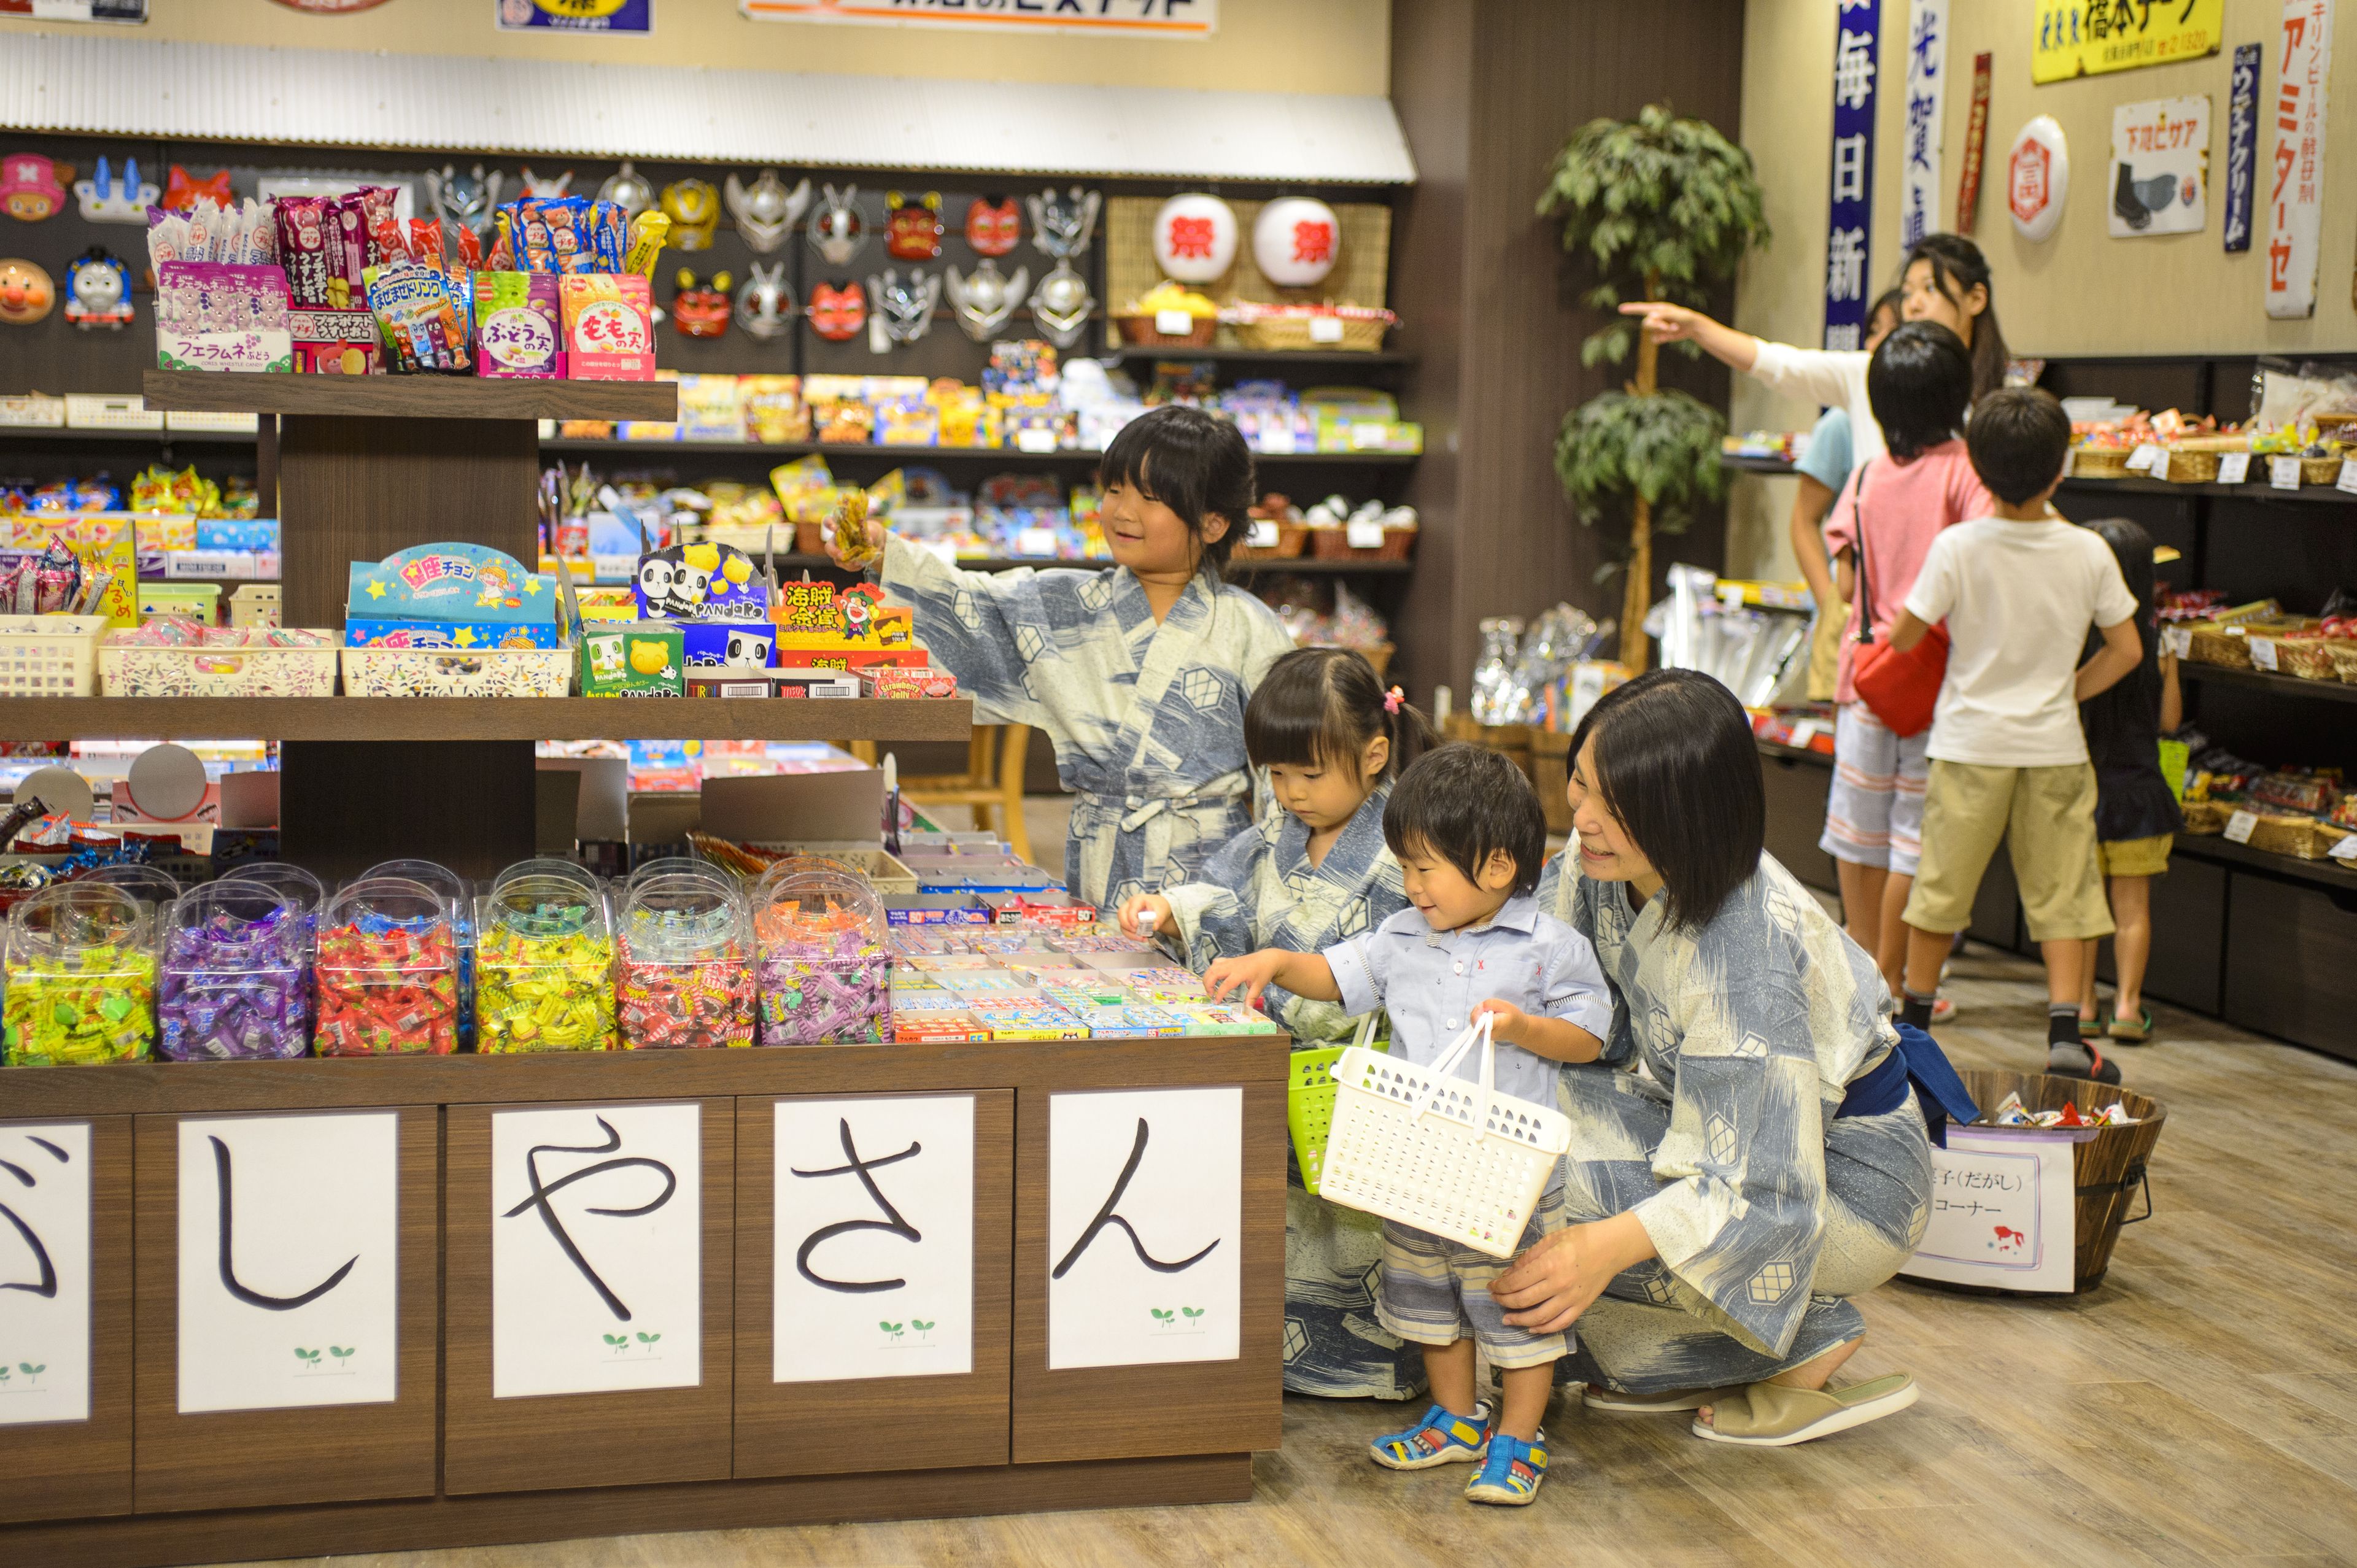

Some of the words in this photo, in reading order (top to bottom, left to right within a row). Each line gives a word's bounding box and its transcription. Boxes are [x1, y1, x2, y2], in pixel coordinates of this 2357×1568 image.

[374, 281, 440, 311] まぜまぜドリンク
[314, 315, 373, 328] プチポテト
[486, 323, 551, 352] ぶどうの実
[582, 315, 642, 349] ももの実
[177, 342, 246, 360] フェラムネ
[247, 350, 270, 361] ぶどう
[786, 585, 833, 607] 海賊
[791, 607, 839, 627] 金貨
[778, 624, 843, 633] ミルクチョコレート
[880, 681, 921, 693] Strawberry
[1935, 1199, 2002, 1217] コーナー
